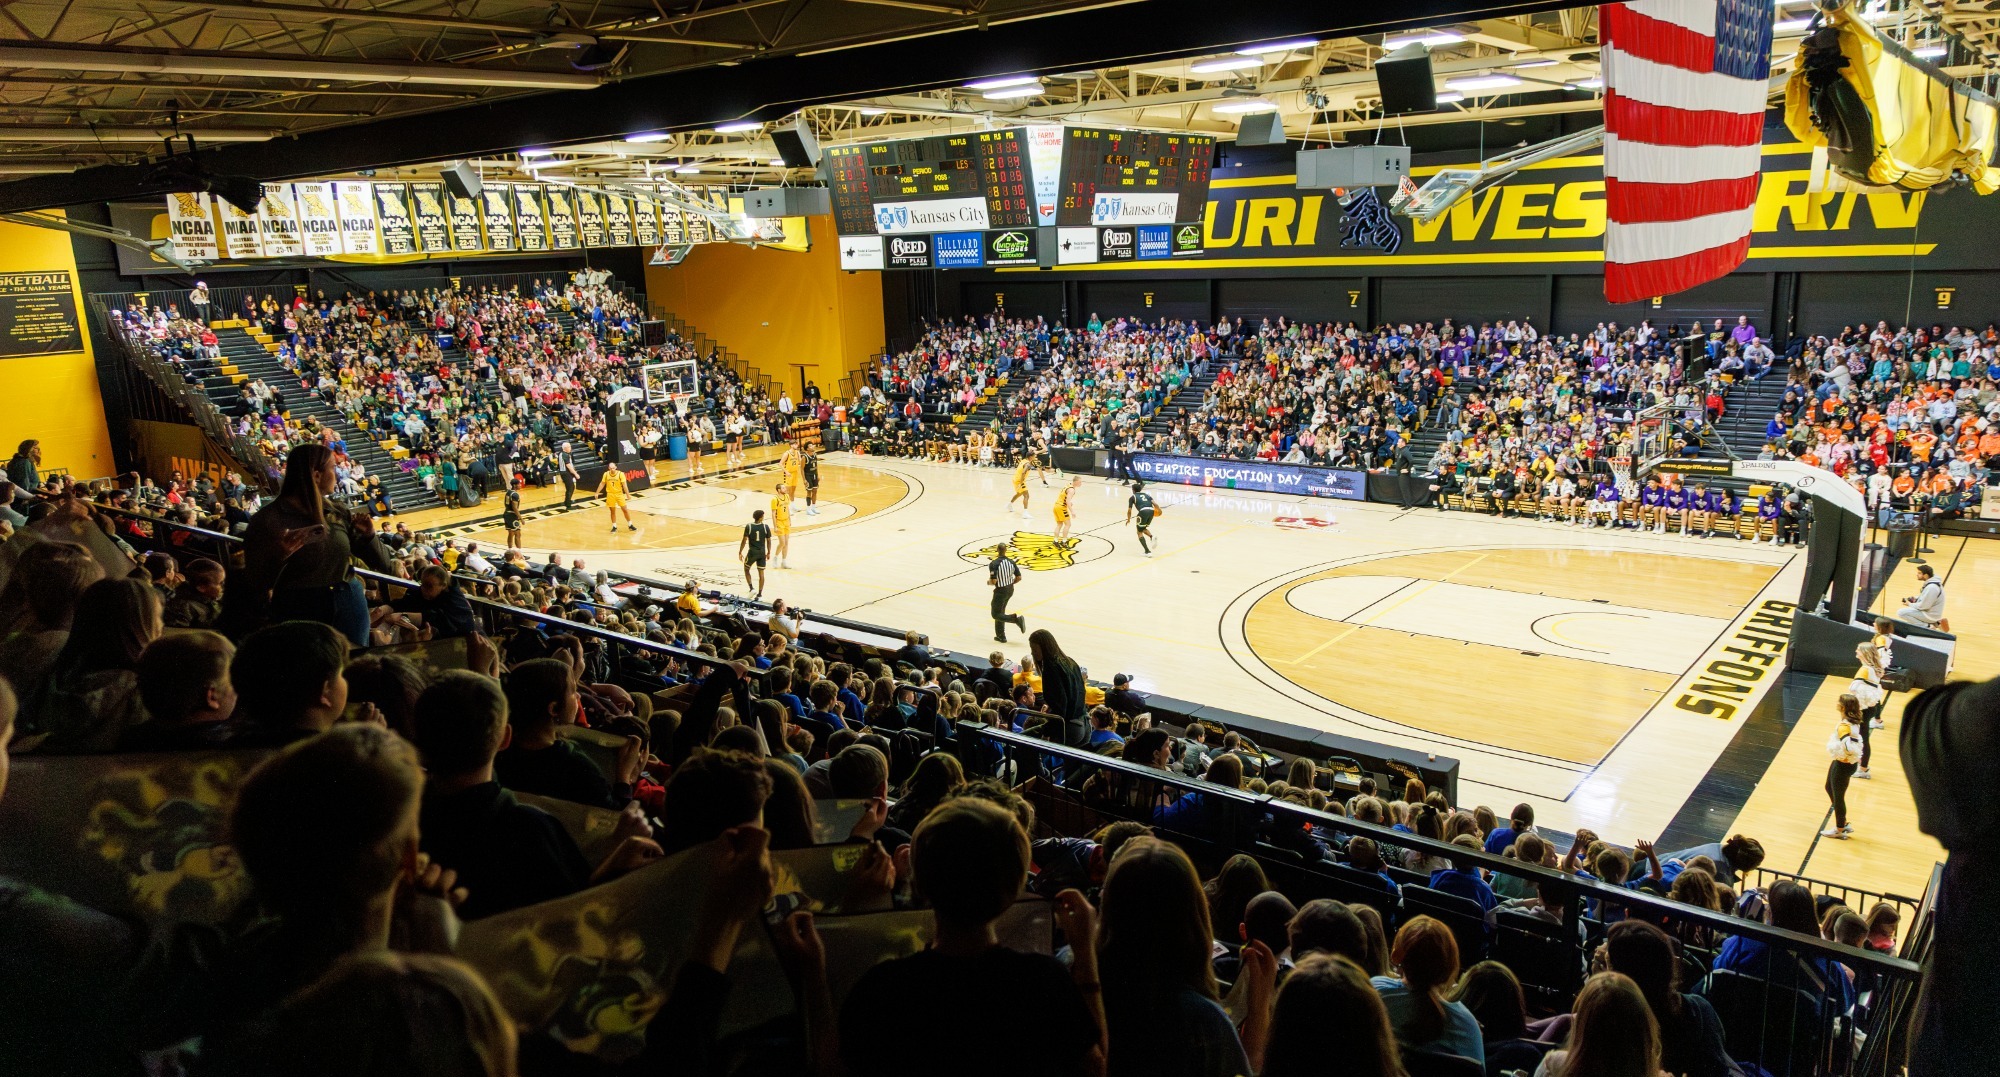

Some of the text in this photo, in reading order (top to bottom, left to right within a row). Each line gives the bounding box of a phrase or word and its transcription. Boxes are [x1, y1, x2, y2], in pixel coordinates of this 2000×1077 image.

[1064, 196, 1074, 208] 25
[910, 205, 986, 225] Kansas City
[1122, 201, 1176, 219] Kansas City
[380, 218, 412, 228] NCAA
[417, 216, 447, 226] NCAA
[451, 216, 480, 226] NCAA
[485, 216, 512, 226] NCAA
[518, 216, 544, 226] NCAA
[550, 216, 576, 225] NCAA
[580, 214, 604, 224] NCAA
[608, 214, 631, 222] NCAA
[662, 214, 683, 222] NCAA
[172, 221, 214, 234] NCAA
[224, 221, 258, 234] MIAA
[262, 220, 298, 232] NCAA
[303, 220, 337, 232] NCAA
[342, 218, 374, 231] NCAA
[1103, 228, 1132, 248] REED
[1140, 230, 1168, 242] HILLYARD
[891, 238, 926, 256] REED
[938, 238, 978, 250] HILLYARD
[140, 297, 147, 306] 1
[997, 296, 1004, 304] 5
[1146, 296, 1152, 304] 6
[1350, 294, 1358, 304] 7
[1938, 292, 1951, 305] 9
[1156, 463, 1200, 477] EMPIRE
[1204, 468, 1272, 484] EDUCATION
[1277, 474, 1302, 486] DAY
[1330, 488, 1354, 496] NURSERY
[756, 530, 760, 542] 1
[1674, 599, 1798, 721] GRIFFONS
